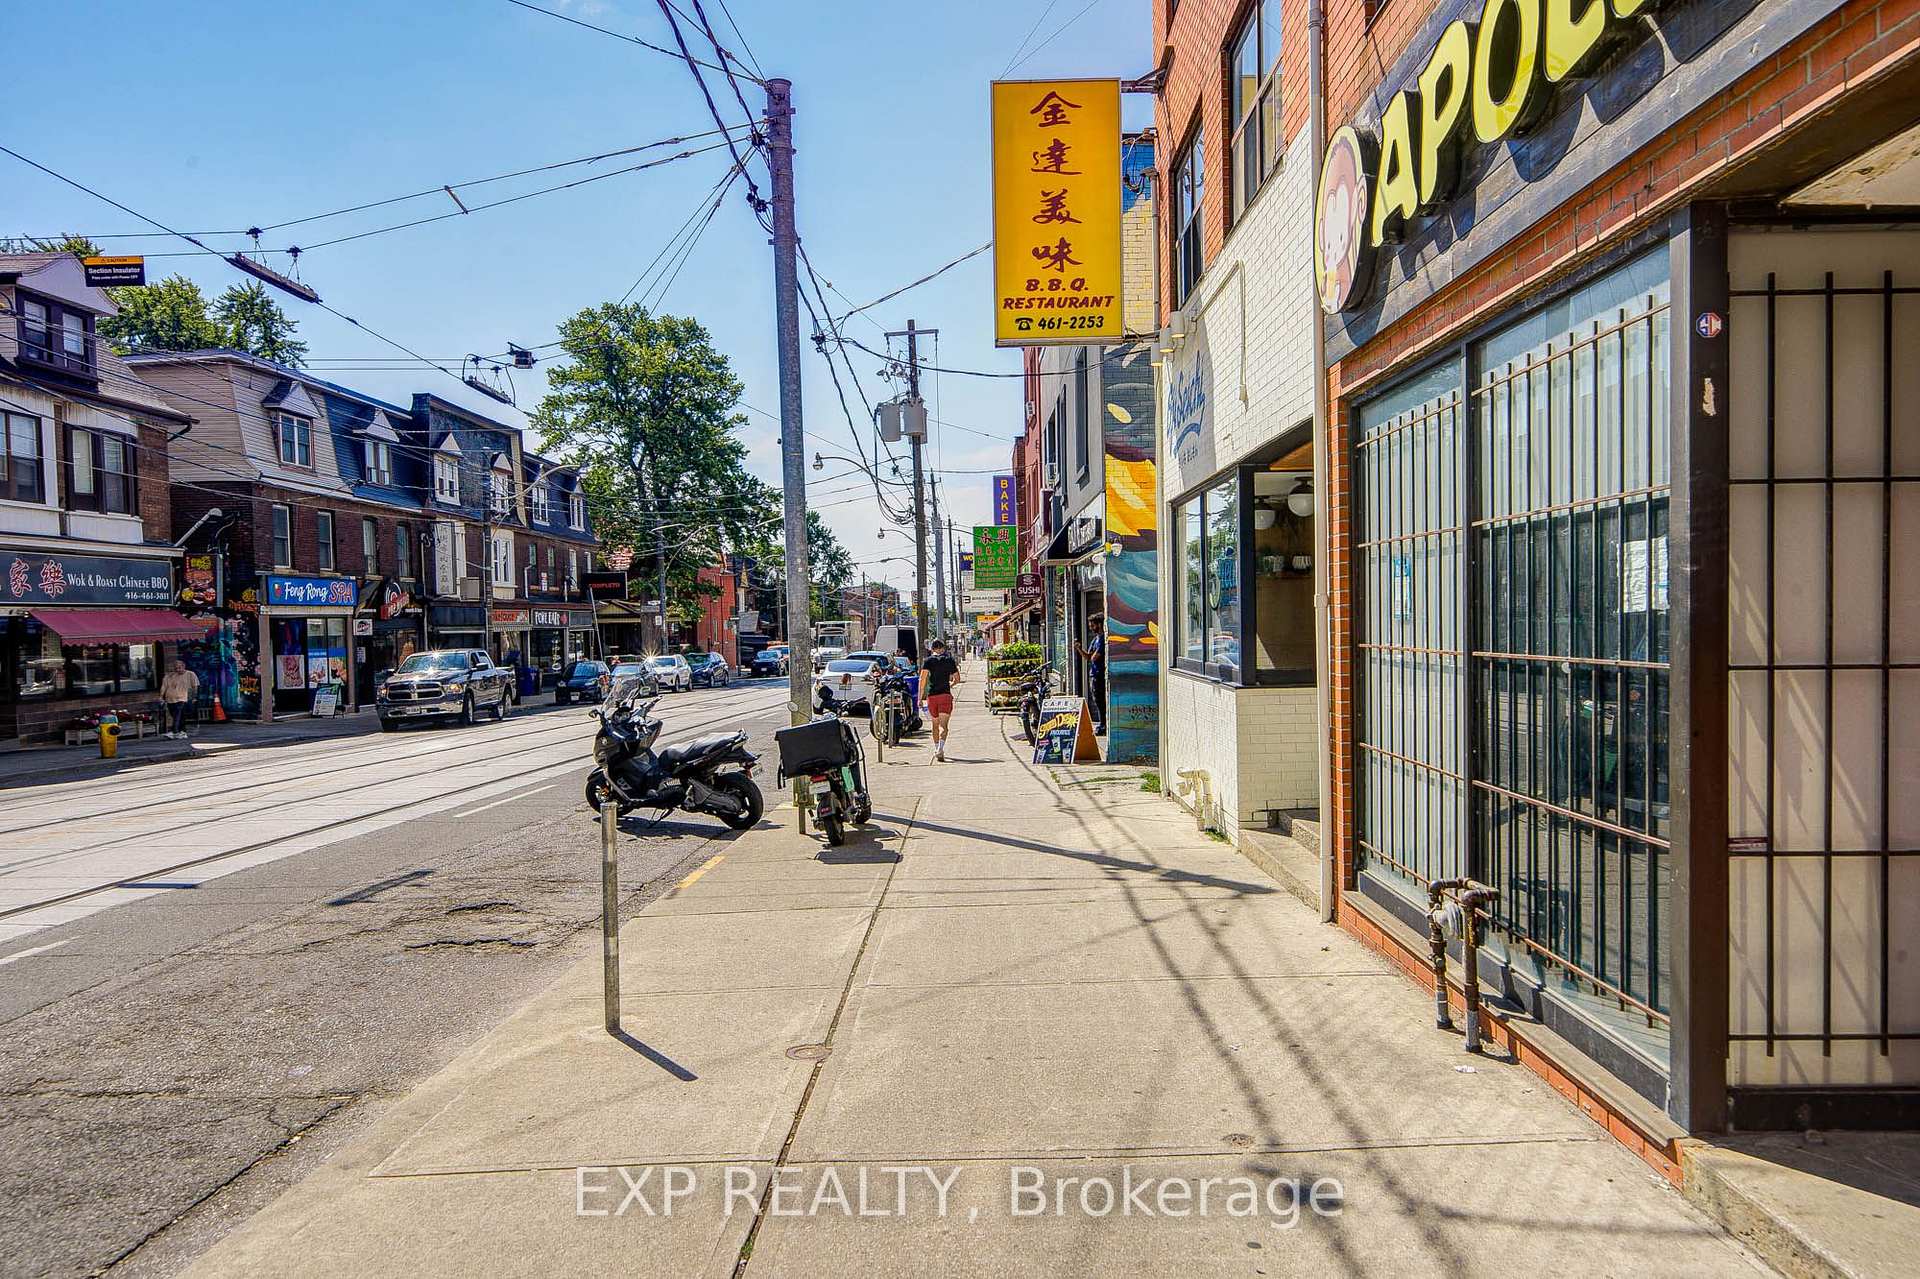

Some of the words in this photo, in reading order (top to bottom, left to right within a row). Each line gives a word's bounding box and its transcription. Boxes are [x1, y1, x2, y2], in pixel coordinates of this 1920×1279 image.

[1371, 0, 1644, 247] APOL
[1030, 90, 1083, 273] 金達美味
[1025, 277, 1089, 292] B.B.Q.
[1003, 295, 1114, 309] RESTAURANT
[1038, 315, 1104, 329] 461-2253
[67, 573, 86, 587] Wok
[87, 575, 94, 586] &
[151, 576, 169, 590] BBQ
[284, 581, 305, 602] Feng
[305, 582, 329, 602] Rong
[328, 581, 354, 603] SPA
[1018, 586, 1040, 595] SUSHI
